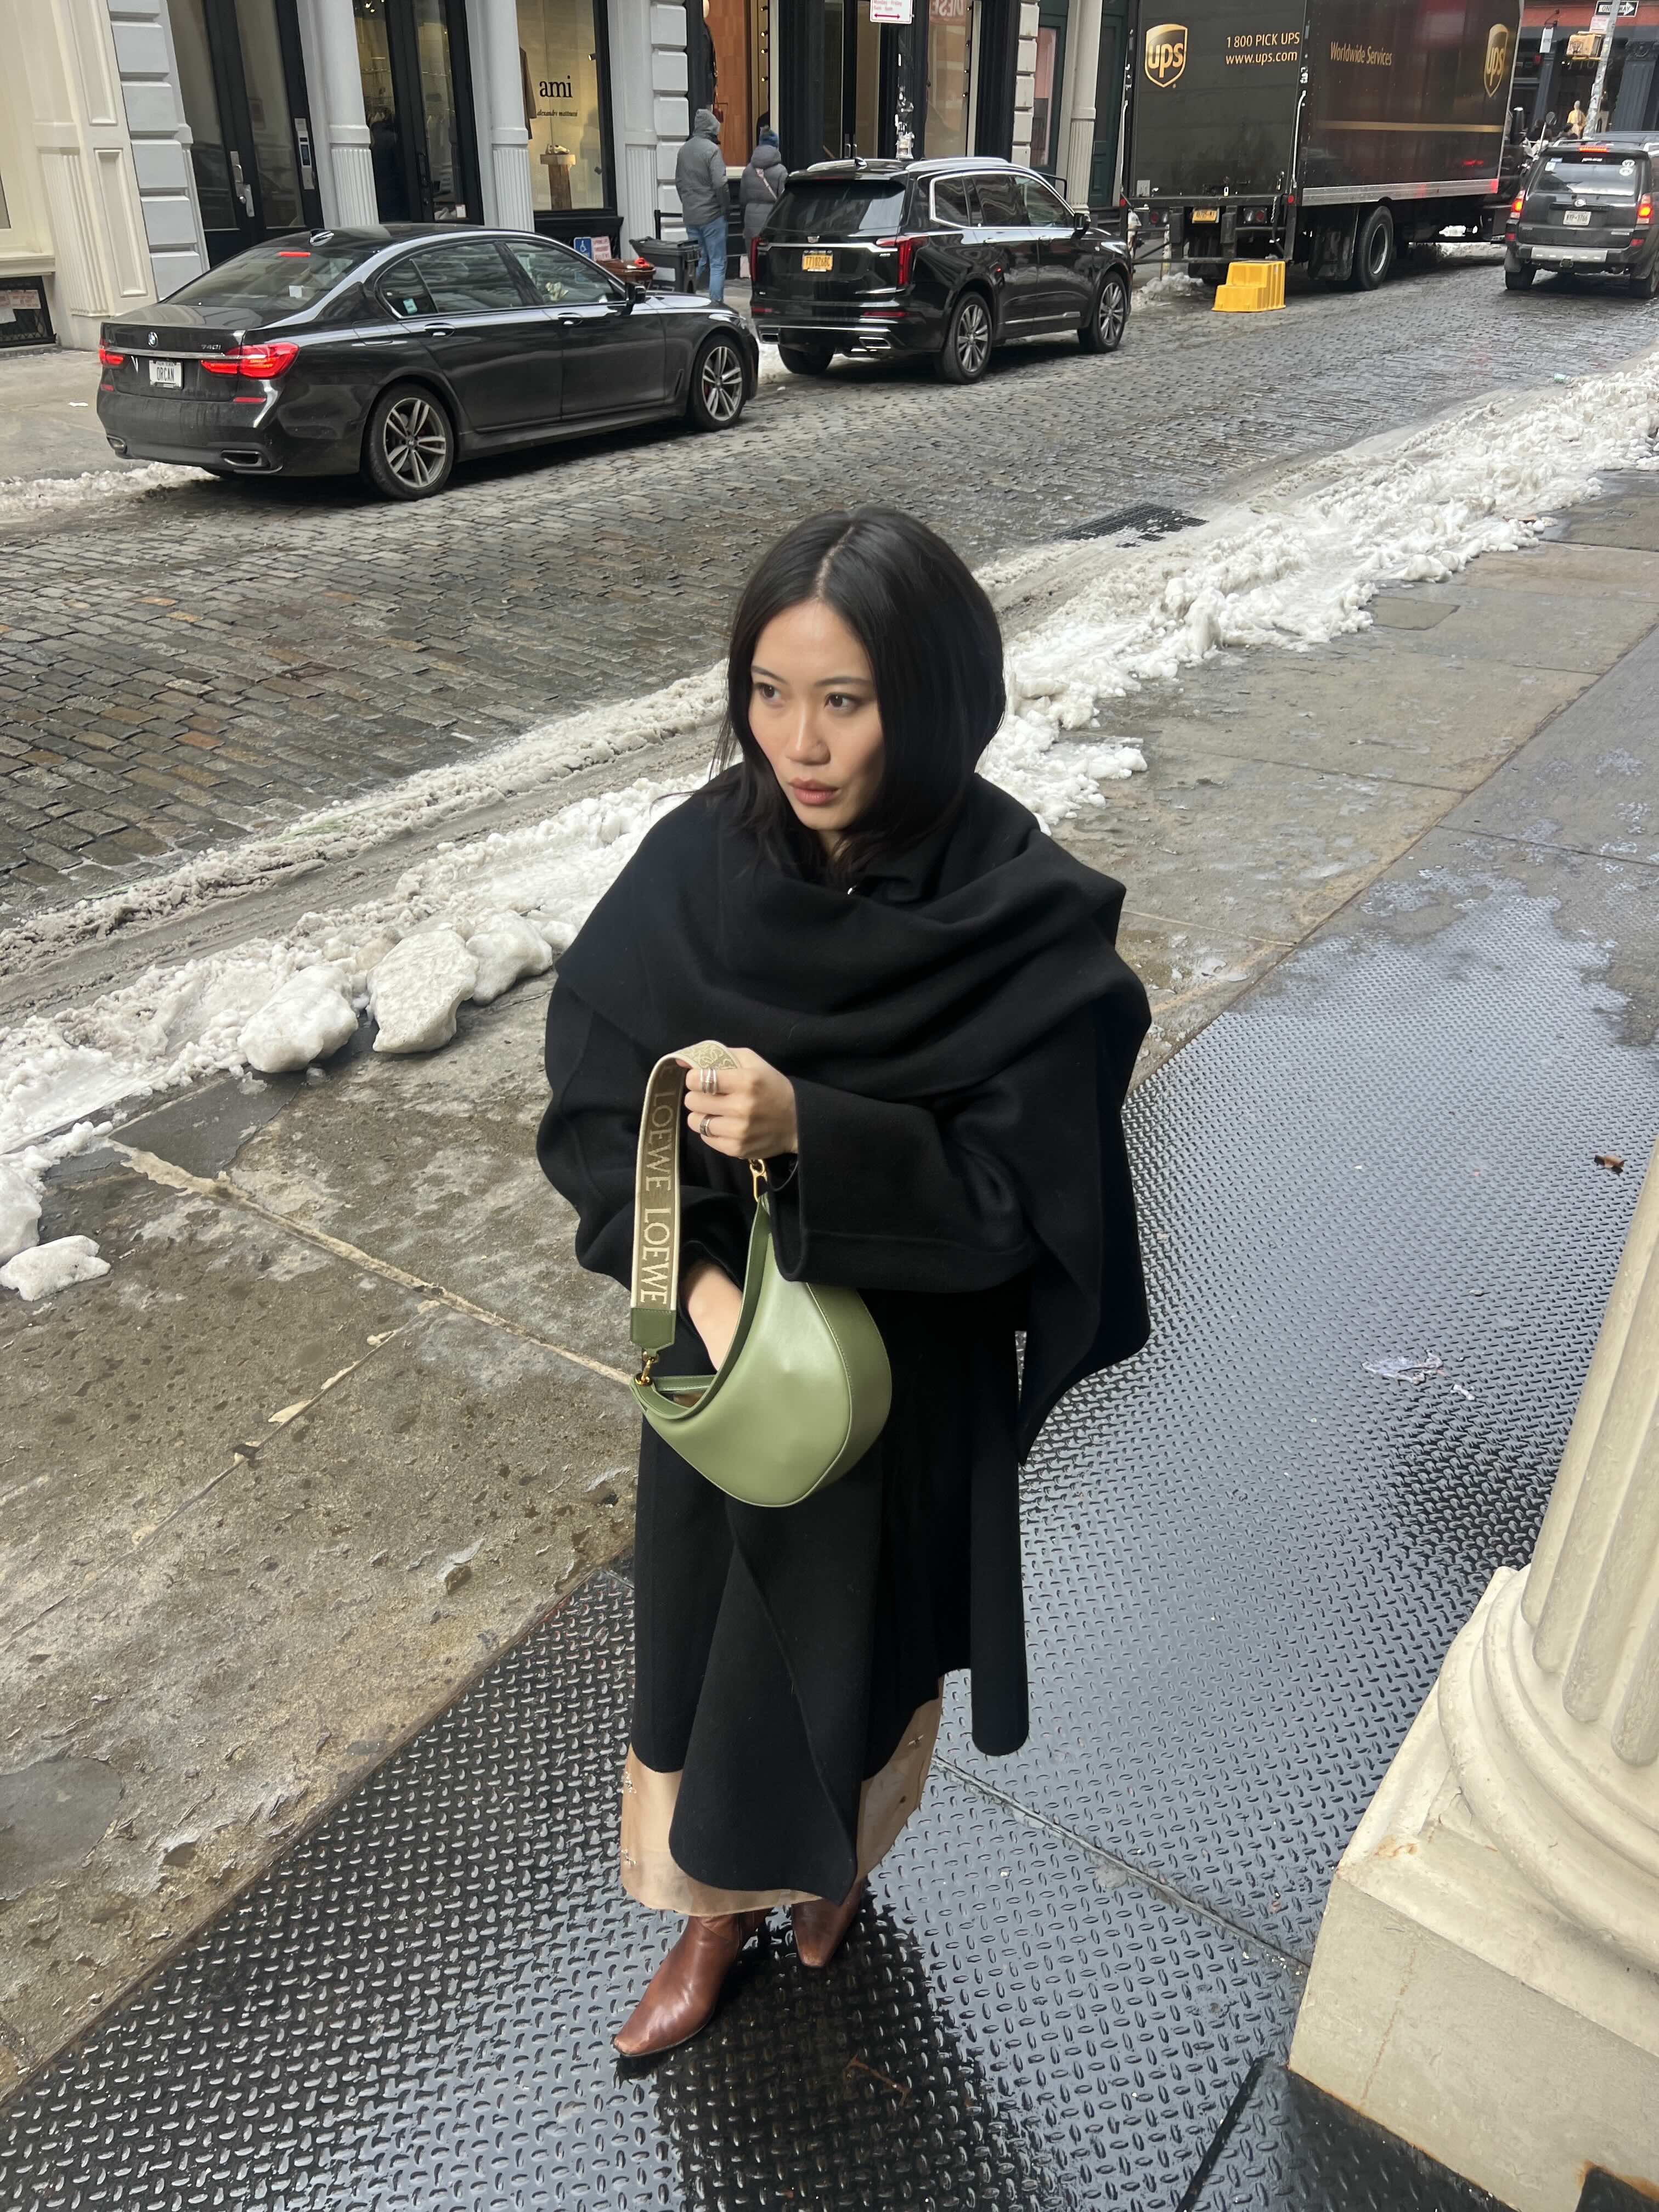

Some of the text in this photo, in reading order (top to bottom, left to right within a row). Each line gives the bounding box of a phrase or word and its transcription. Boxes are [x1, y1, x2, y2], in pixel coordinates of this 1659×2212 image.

[1227, 32, 1300, 48] 1 800 PICK UPS
[1148, 43, 1183, 78] ups
[1226, 51, 1297, 65] www.ups.com
[1330, 41, 1392, 66] Worldwide Services
[1486, 46, 1504, 86] ups
[539, 75, 573, 98] ami
[157, 366, 174, 381] ORCAN
[645, 1092, 676, 1192] LOEWE
[641, 1208, 672, 1304] LOEWE
